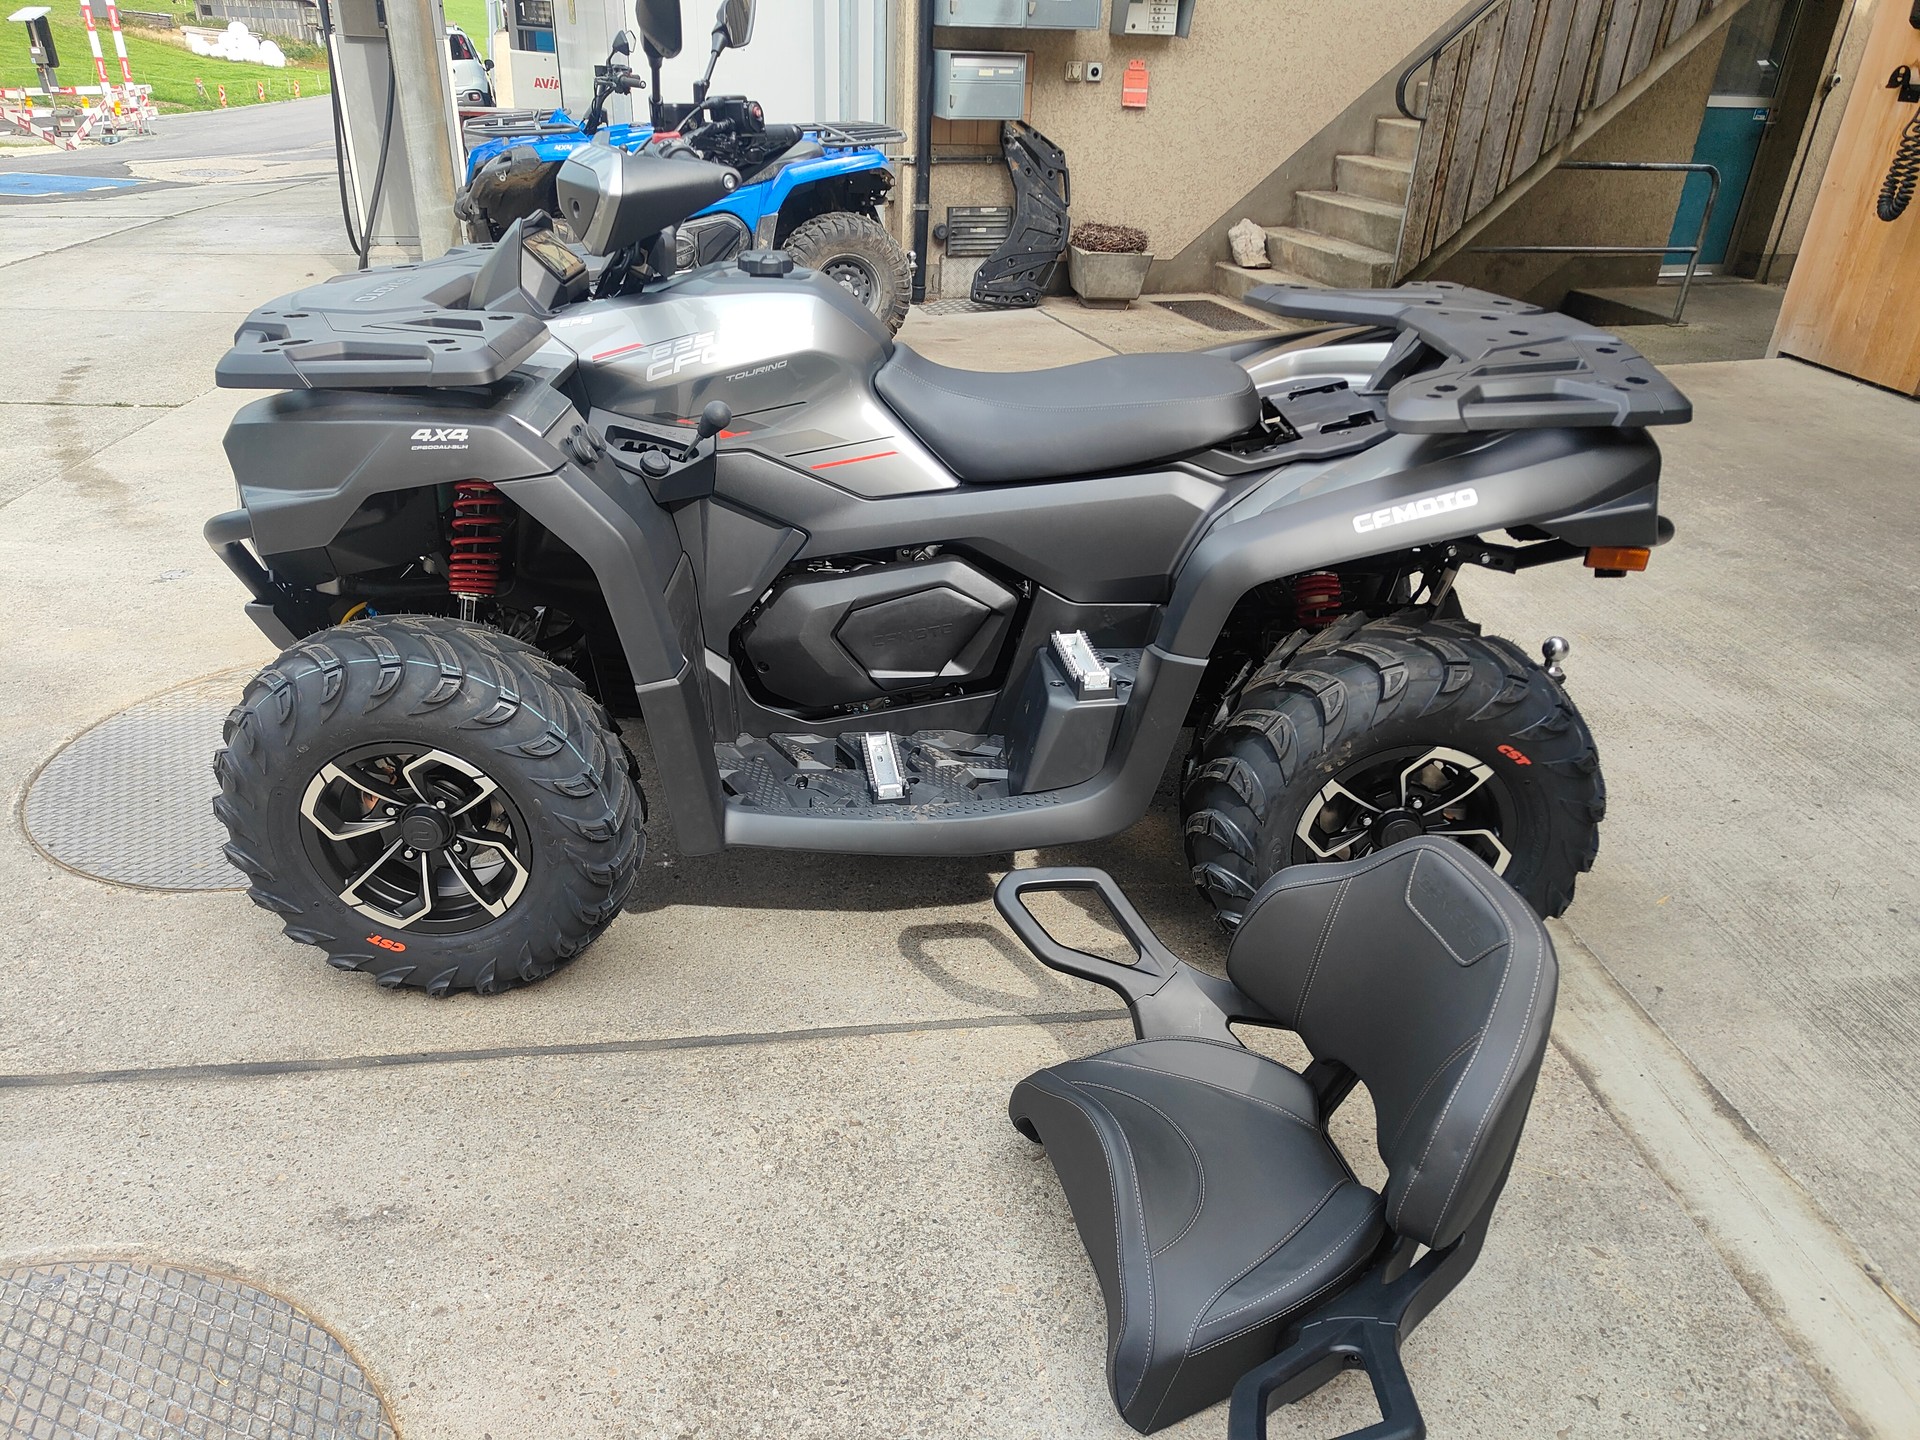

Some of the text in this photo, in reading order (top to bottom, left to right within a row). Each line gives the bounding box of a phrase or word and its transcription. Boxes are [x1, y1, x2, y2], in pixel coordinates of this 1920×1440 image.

[519, 2, 526, 16] 1
[558, 316, 594, 328] EPS
[652, 330, 716, 360] 625
[726, 360, 788, 382] TOURING
[411, 428, 469, 441] 4X4
[1352, 487, 1479, 534] CFMOTO
[1496, 744, 1532, 766] CST
[366, 934, 406, 952] CST
